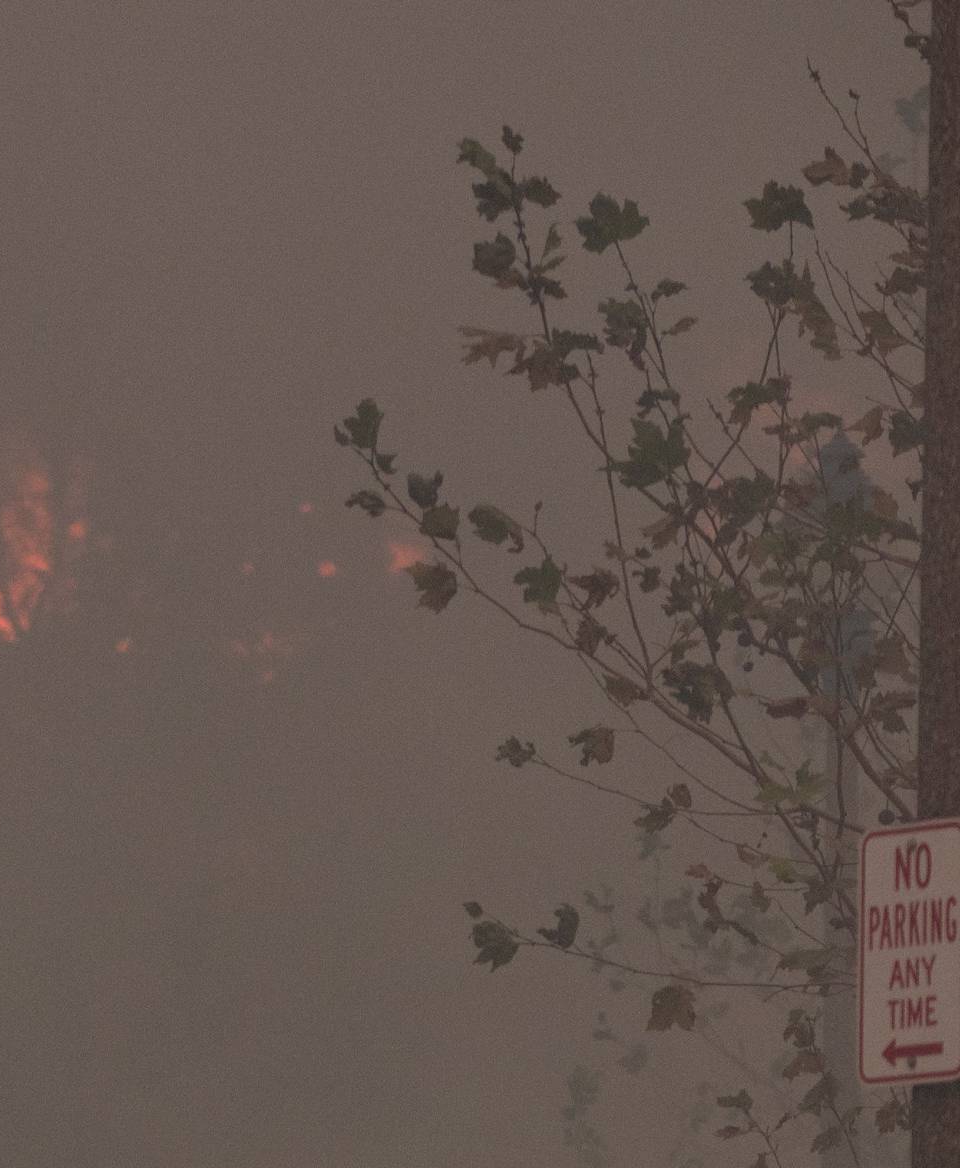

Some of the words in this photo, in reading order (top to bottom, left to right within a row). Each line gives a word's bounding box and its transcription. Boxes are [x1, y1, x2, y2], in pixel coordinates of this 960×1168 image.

[895, 844, 931, 891] NO
[868, 896, 957, 951] PARKING
[889, 955, 936, 989] ANY
[888, 997, 938, 1030] TIME
